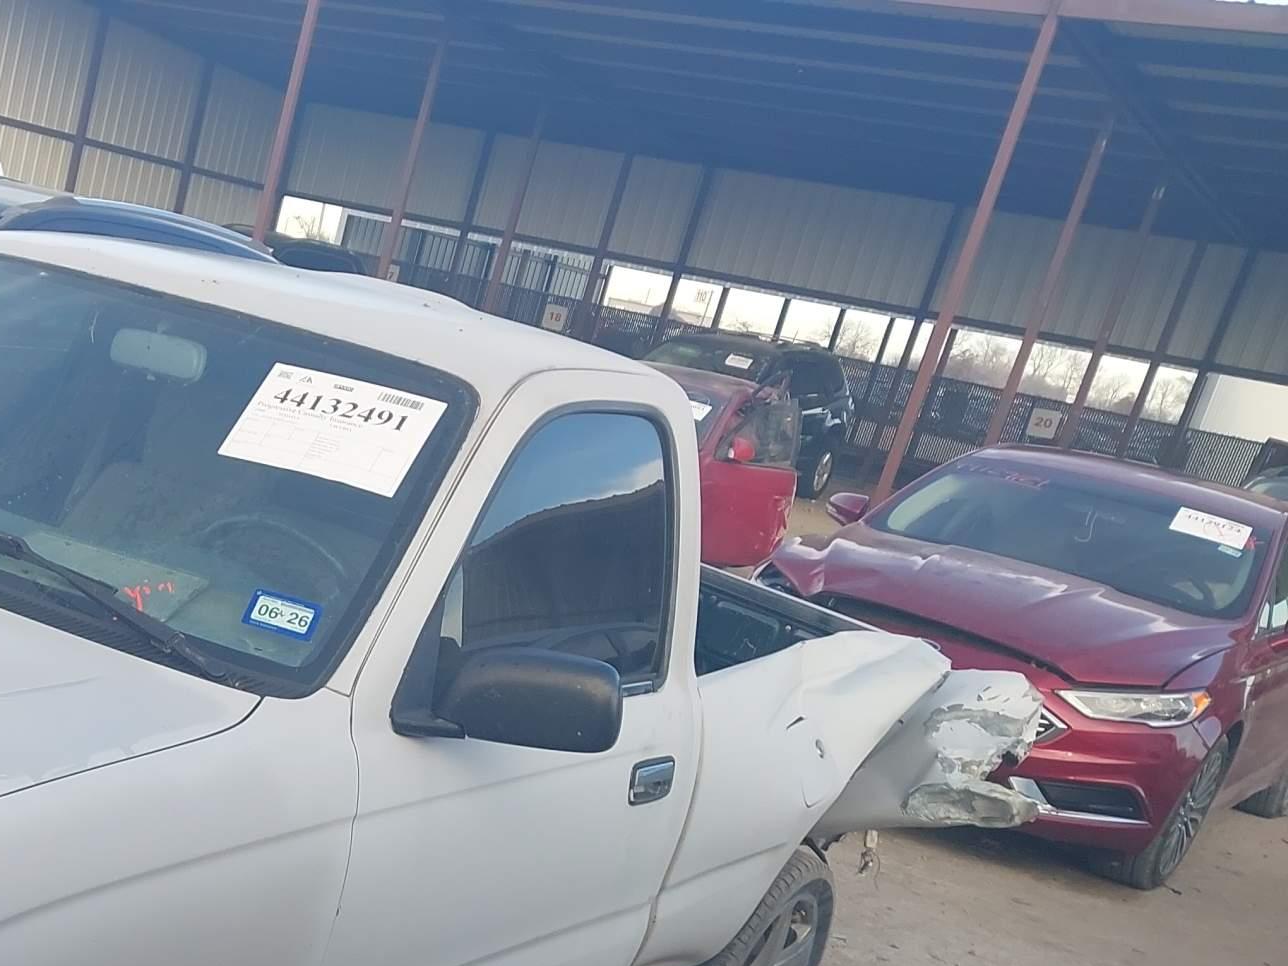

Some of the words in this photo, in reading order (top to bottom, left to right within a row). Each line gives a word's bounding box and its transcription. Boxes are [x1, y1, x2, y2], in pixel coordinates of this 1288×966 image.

[550, 311, 562, 322] 18
[273, 387, 410, 433] 44132491
[1033, 416, 1053, 428] 20
[257, 603, 280, 620] 06
[286, 610, 310, 628] 26
